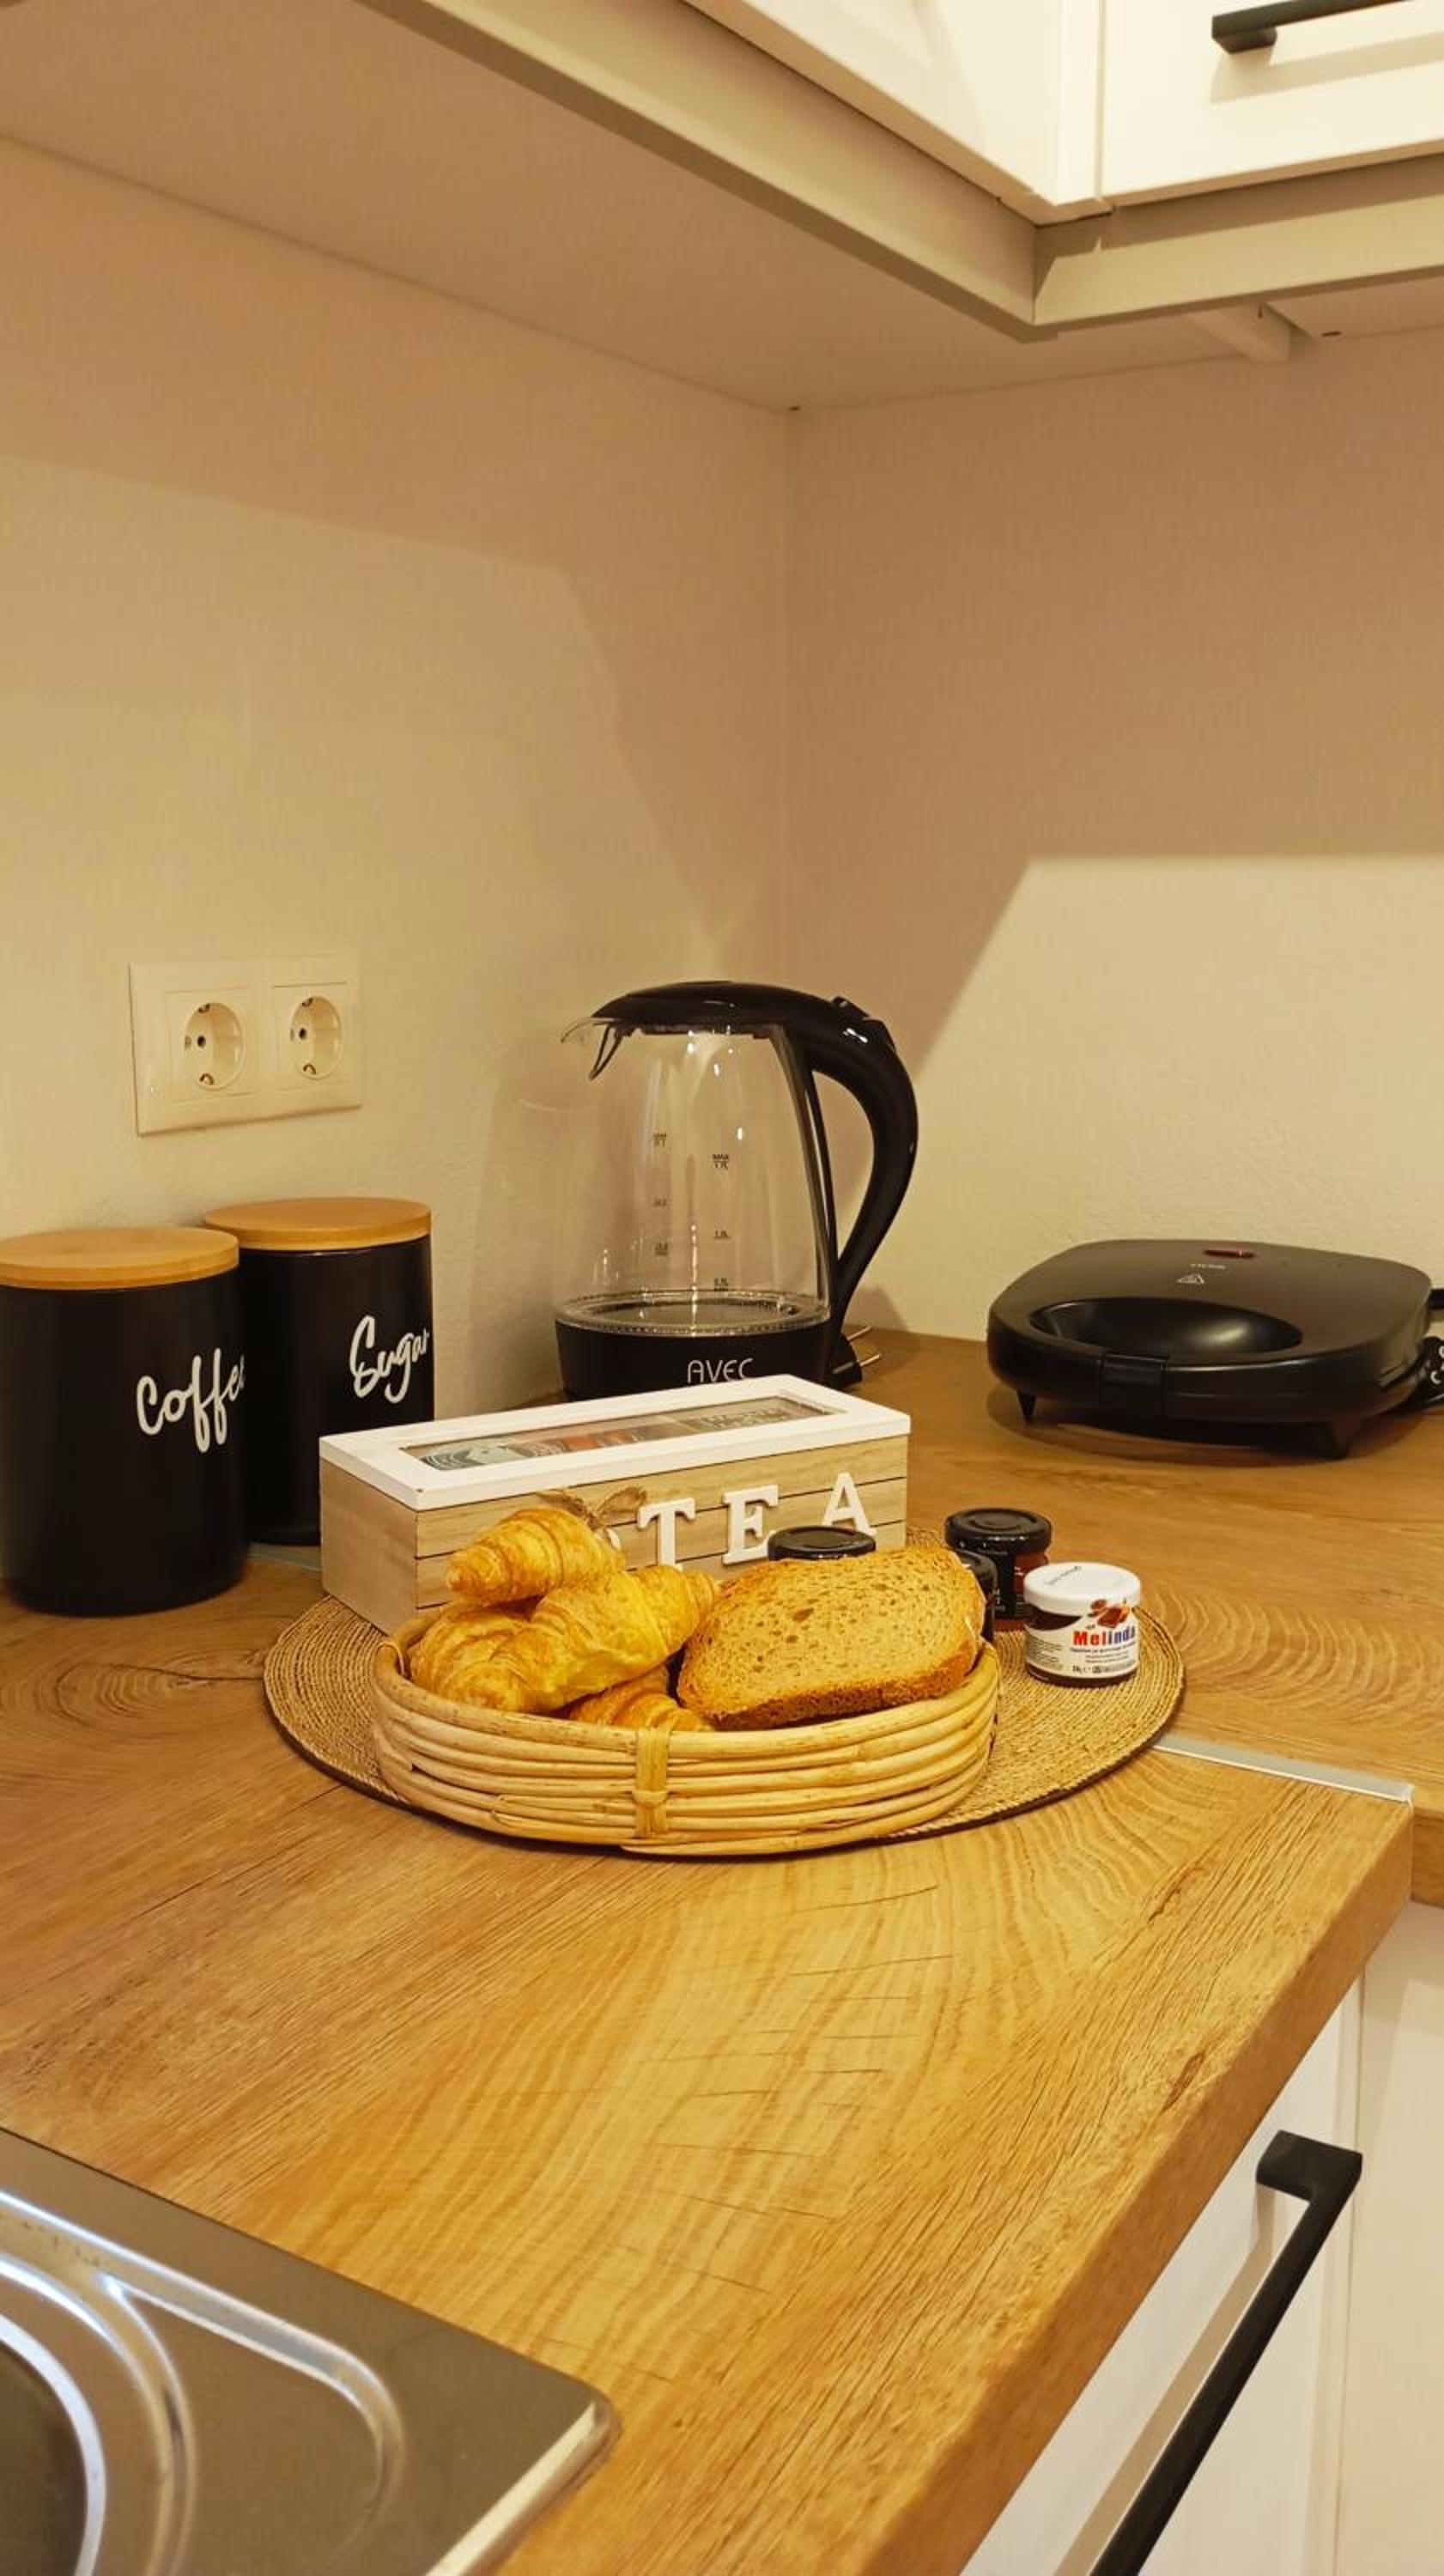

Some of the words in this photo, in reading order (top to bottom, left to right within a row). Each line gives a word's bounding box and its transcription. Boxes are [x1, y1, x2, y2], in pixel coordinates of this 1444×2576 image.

[349, 1315, 429, 1403] Sugar
[688, 1358, 753, 1384] AVEC
[637, 1472, 877, 1572] TEA
